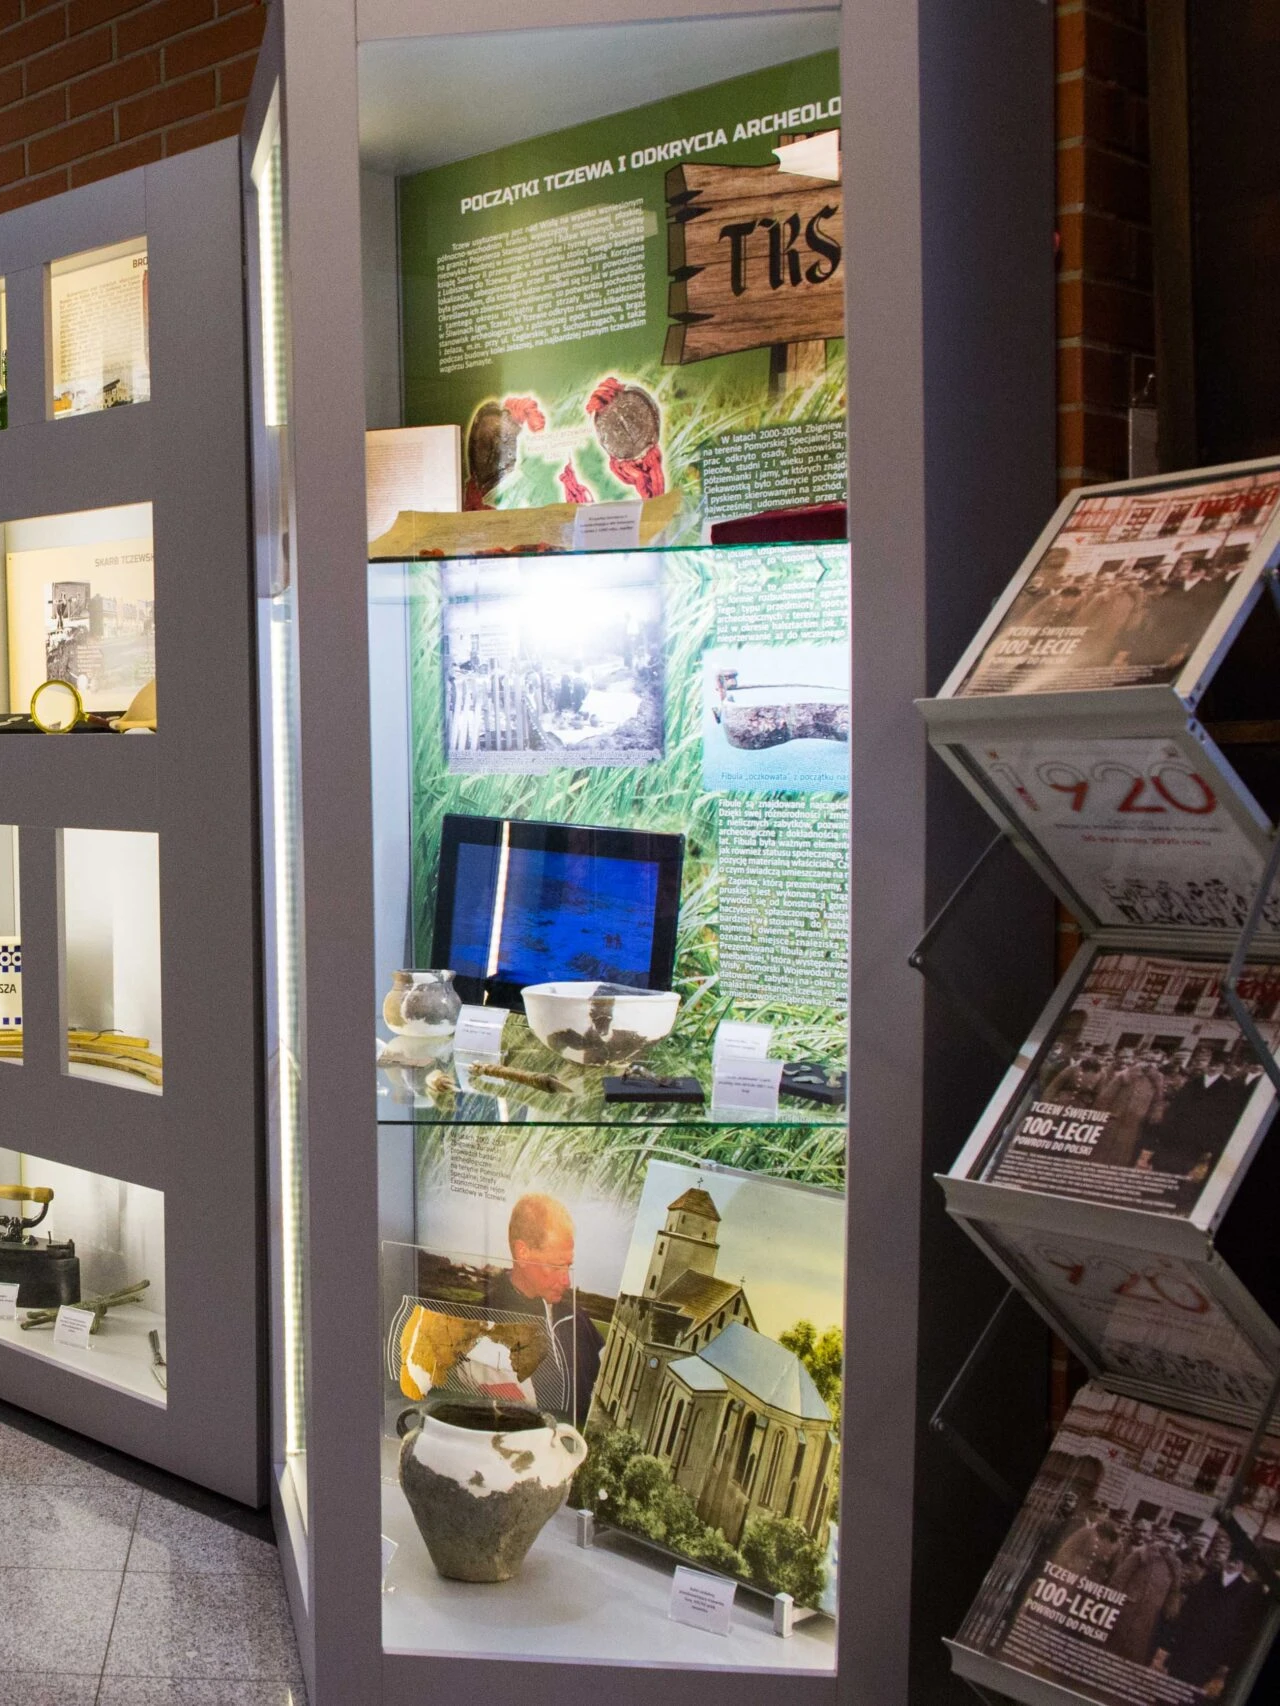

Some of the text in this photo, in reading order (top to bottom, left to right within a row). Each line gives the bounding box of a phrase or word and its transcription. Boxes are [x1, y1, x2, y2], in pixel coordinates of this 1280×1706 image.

[461, 96, 841, 215] POCZĄTKI TCZEWA I ODKRYCIA ARCHEOLO
[721, 420, 842, 444] W latach 2000-2004 Zbigniew
[703, 448, 712, 456] na
[715, 444, 741, 455] terenie
[744, 437, 787, 453] Pomorskiej
[789, 432, 830, 447] Specjalnej
[703, 457, 720, 467] prac
[725, 452, 756, 465] odkryto
[736, 461, 760, 471] studni
[780, 456, 803, 466] wieku
[792, 464, 821, 476] których
[755, 479, 771, 489] było
[775, 475, 808, 487] odkrycie
[711, 492, 741, 504] pyskiem
[745, 487, 796, 501] skierowanym
[799, 486, 809, 494] na
[757, 495, 809, 508] udomowione
[996, 639, 1081, 656] 100-LECIE
[990, 760, 1217, 815] 1920
[810, 920, 821, 928] do
[1030, 1101, 1111, 1123] TCZEW ŚWIĘTUJE
[1022, 1116, 1104, 1145] 100-LECIE
[1013, 1135, 1094, 1156] POWROTU DO POLSKI
[1043, 1561, 1127, 1607] TCZEW ŚWIĘTUJE
[1033, 1578, 1120, 1630] 100-LECIE
[1025, 1598, 1109, 1643] POWROTU DO POLSKI
